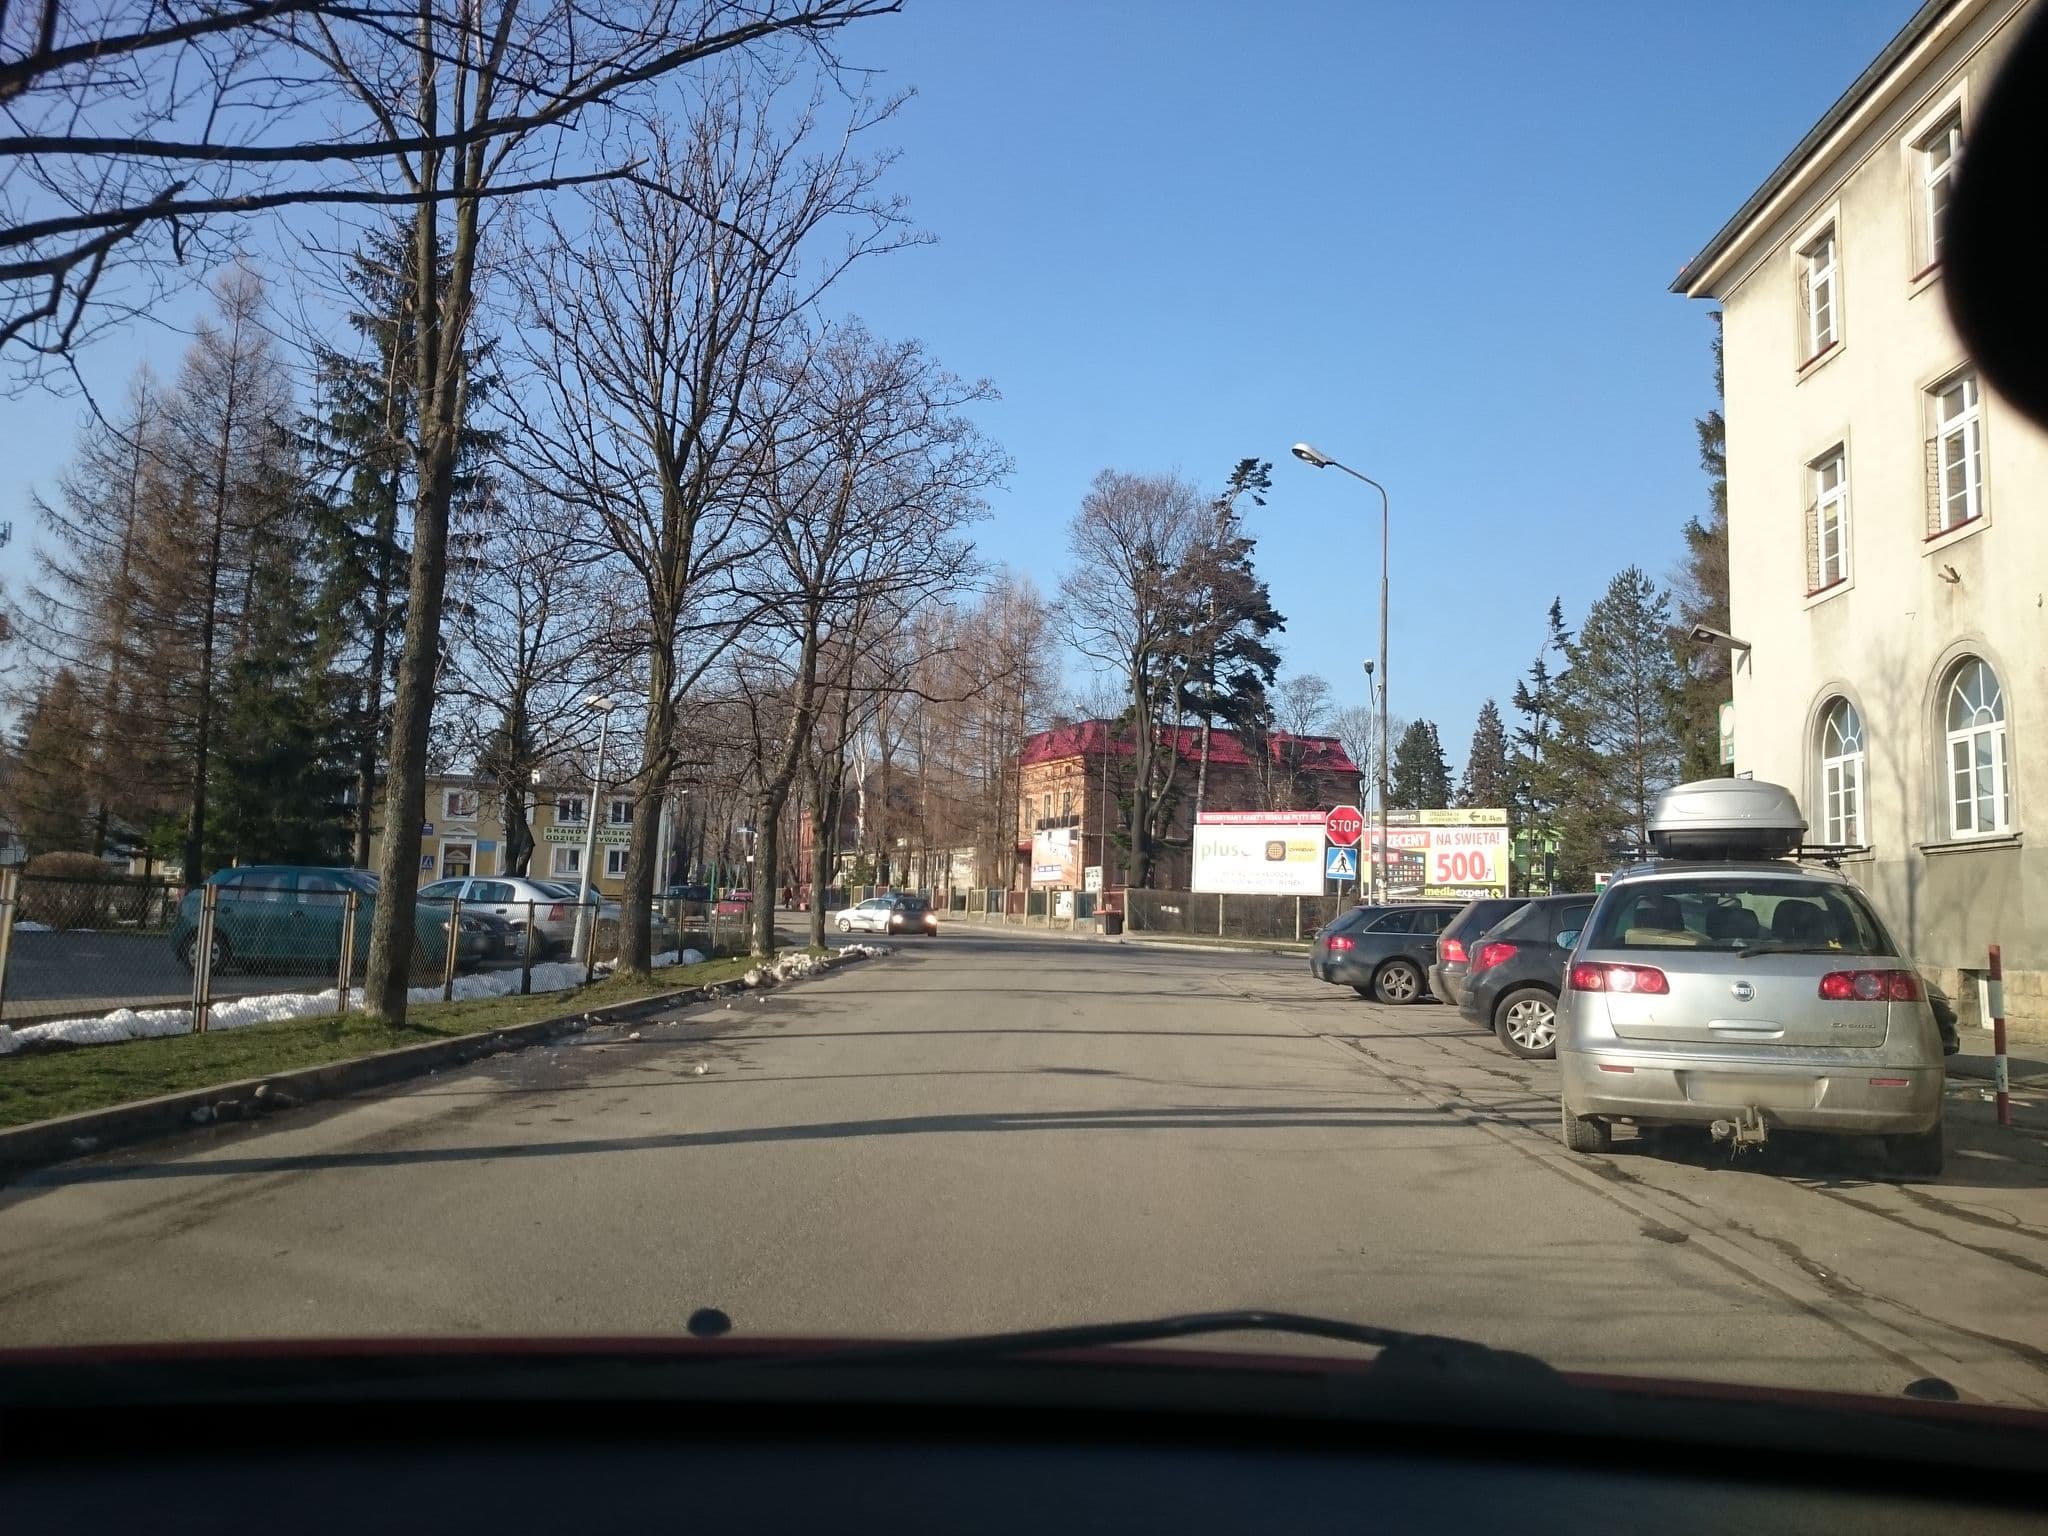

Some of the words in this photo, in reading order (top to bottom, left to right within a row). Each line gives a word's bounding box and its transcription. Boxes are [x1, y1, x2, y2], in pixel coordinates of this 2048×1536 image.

[1330, 819, 1360, 832] STOP
[546, 828, 631, 837] SKANDYAWSKA
[1436, 832, 1452, 846] NA
[1201, 840, 1239, 861] plus
[1424, 886, 1490, 898] mediaexpert
[1736, 987, 1751, 995] FIAT
